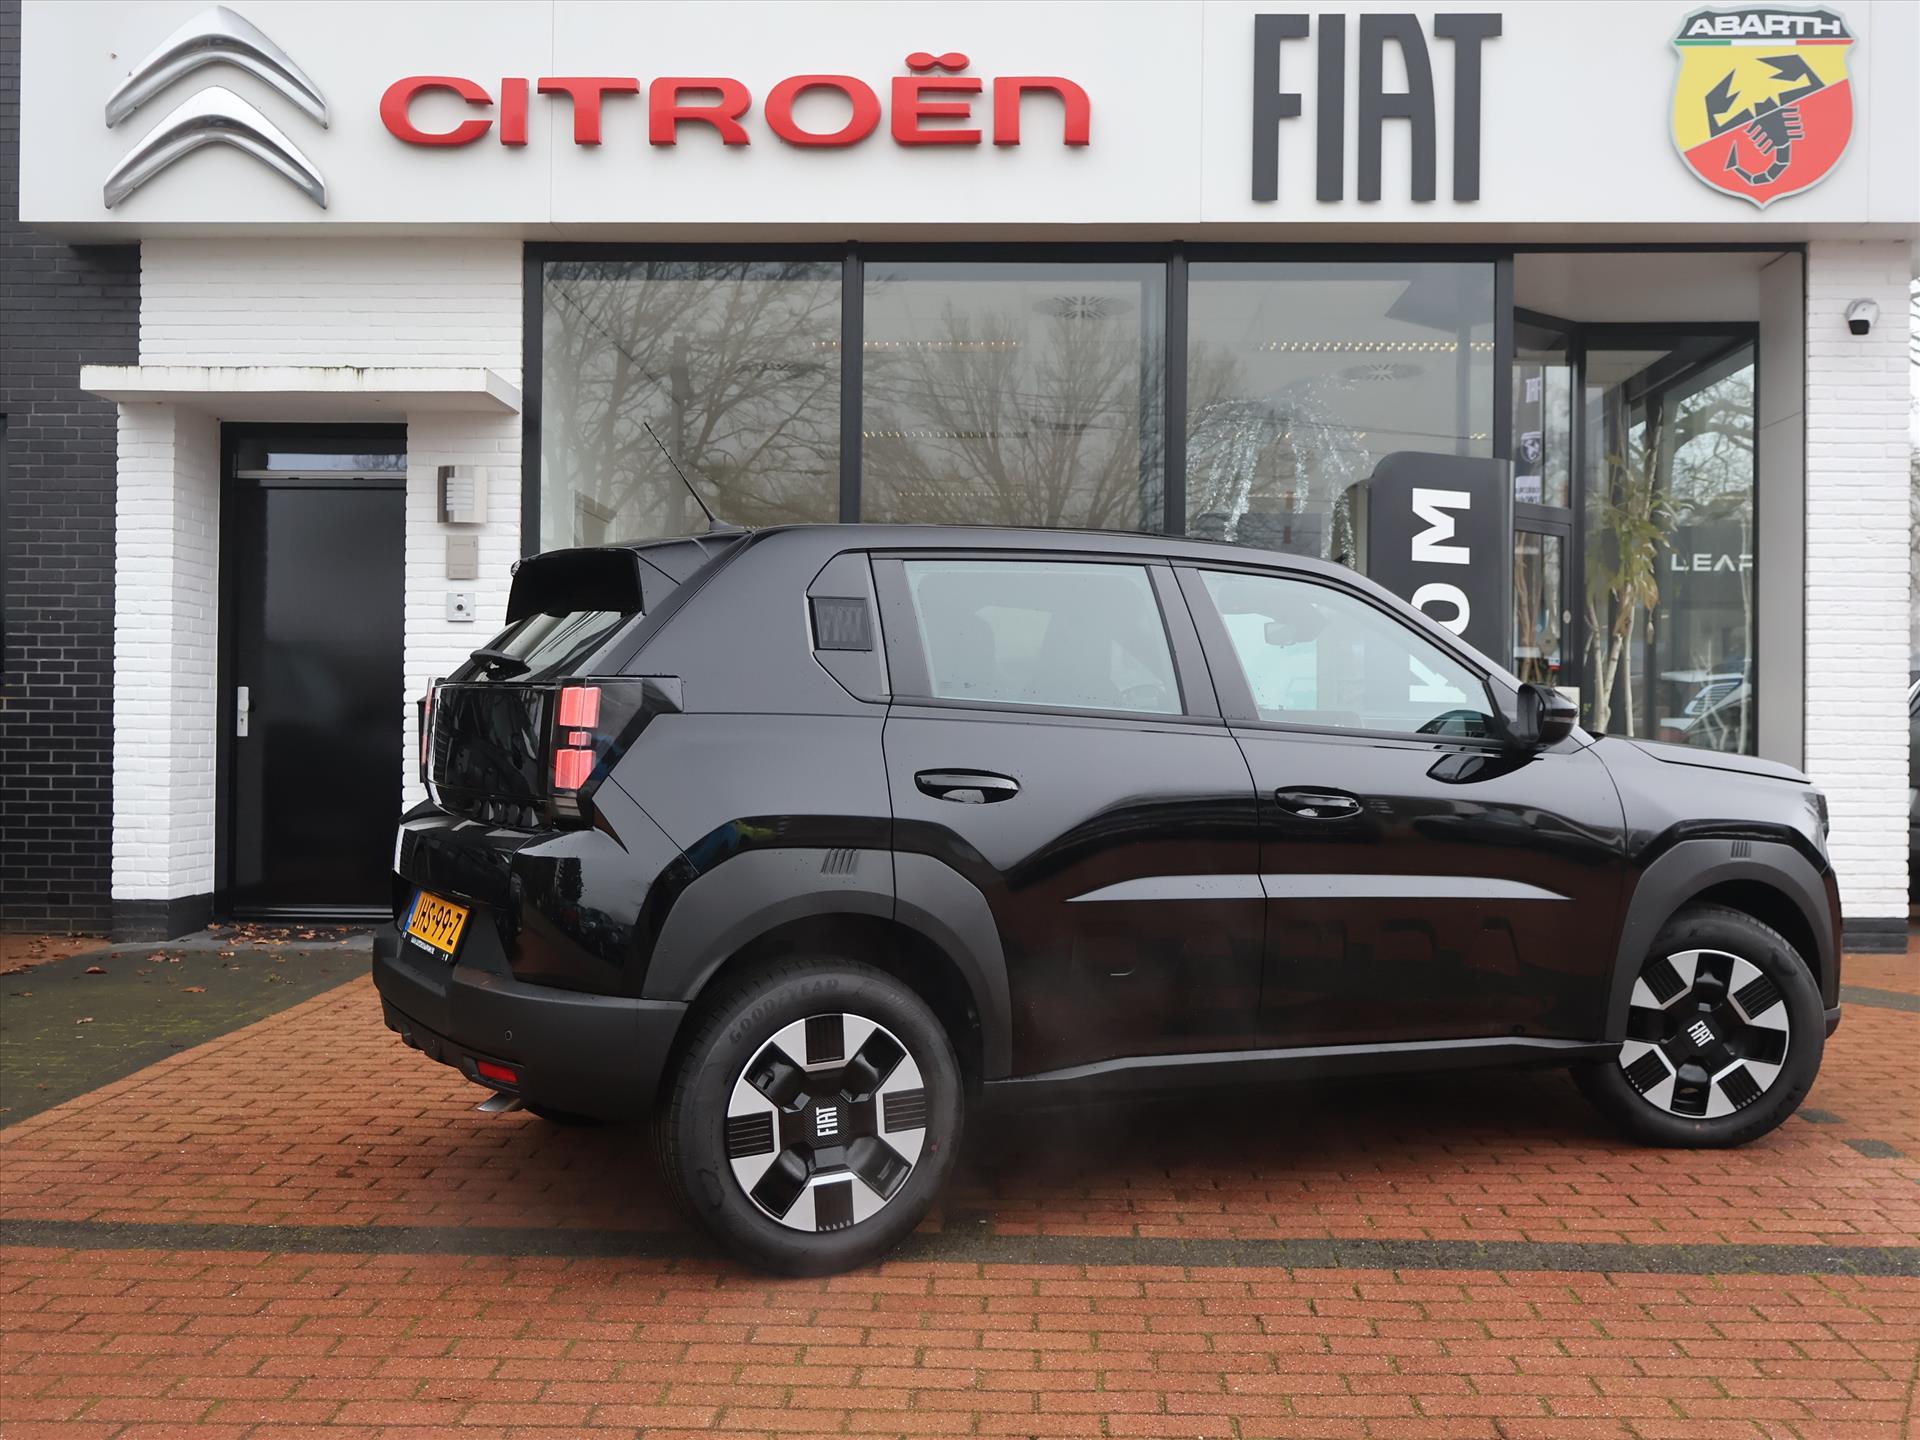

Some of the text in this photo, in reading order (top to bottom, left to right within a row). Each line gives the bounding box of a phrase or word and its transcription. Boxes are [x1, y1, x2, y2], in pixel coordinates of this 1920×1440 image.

[1687, 14, 1841, 36] ABARTH
[1252, 13, 1502, 201] FIAT
[413, 898, 462, 946] JHS-99-Z
[729, 978, 839, 1044] GOODYEAR
[1688, 1021, 1716, 1047] FIAT
[816, 1106, 837, 1137] FIAT
